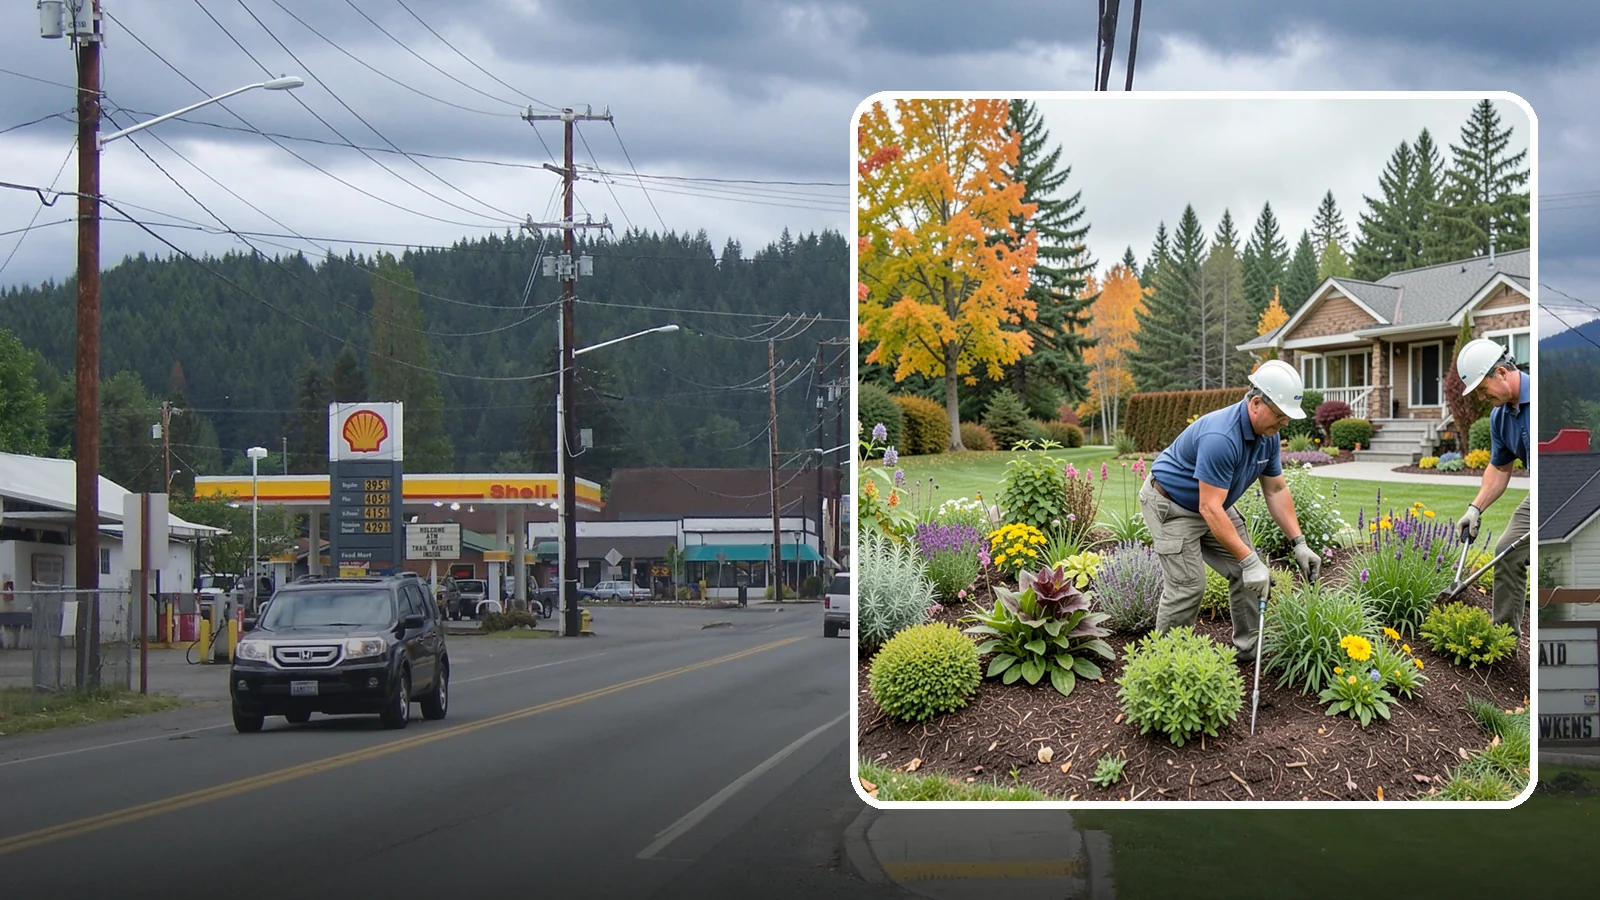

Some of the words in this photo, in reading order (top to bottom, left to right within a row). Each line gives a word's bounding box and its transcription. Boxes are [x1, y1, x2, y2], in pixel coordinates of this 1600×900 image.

[366, 480, 383, 490] 395
[490, 484, 547, 499] Shell
[366, 494, 383, 504] 405
[366, 508, 383, 518] 415
[366, 522, 383, 532] 429
